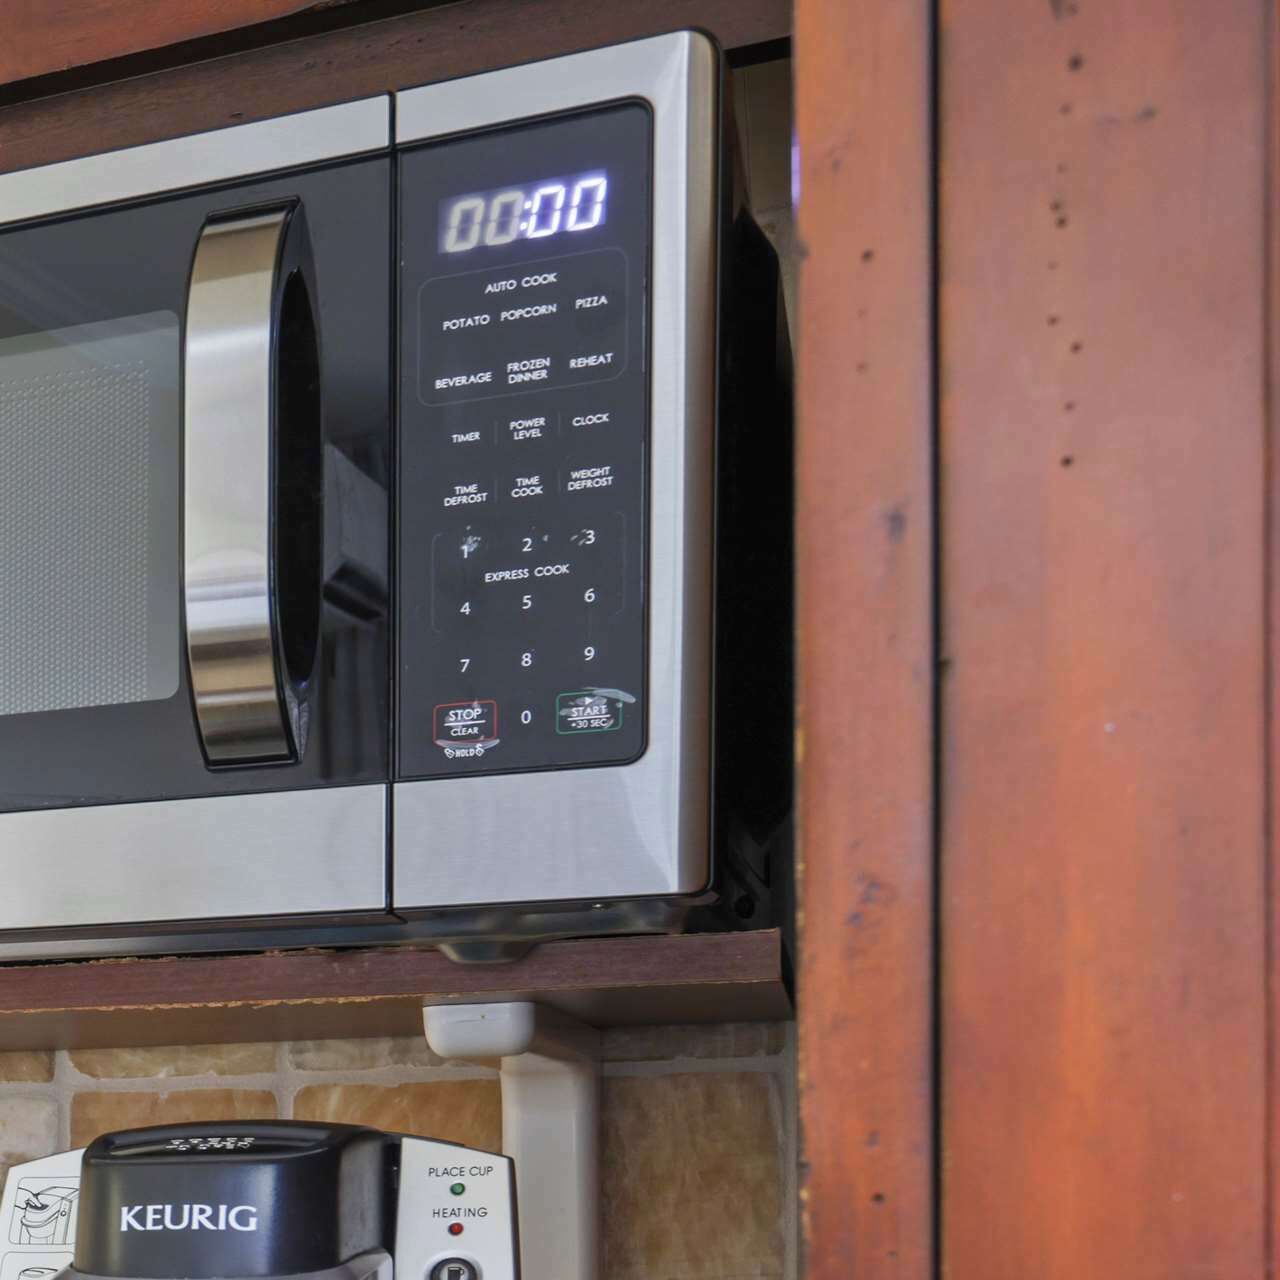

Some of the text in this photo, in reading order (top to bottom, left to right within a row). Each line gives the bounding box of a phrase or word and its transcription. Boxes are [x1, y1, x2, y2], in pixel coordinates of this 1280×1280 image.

[445, 176, 608, 253] 00:00
[484, 273, 558, 294] AUTO COOK
[576, 296, 608, 309] PIZZA
[500, 304, 557, 321] POPCORN
[442, 314, 490, 330] POTATO
[507, 358, 550, 372] FROZEN
[570, 353, 613, 368] REHEAT
[435, 372, 492, 389] BEVERAGE
[508, 370, 548, 384] DINNER
[510, 418, 546, 430] POWER
[572, 413, 610, 426] CLOCK
[452, 432, 480, 444] TIMER
[514, 429, 542, 440] LEVEL
[571, 466, 611, 480] WEIGHT
[516, 476, 540, 487] TIME
[568, 477, 614, 491] DEFROST
[454, 484, 478, 495] TIME
[511, 486, 543, 498] COOK
[444, 493, 488, 506] DEFROST
[585, 530, 596, 544] 3
[522, 538, 532, 552] 2
[484, 564, 569, 582] EXPRESS COOK
[584, 588, 595, 602] 6
[460, 602, 471, 615] 4
[522, 595, 532, 609] 5
[521, 653, 532, 667] 8
[584, 647, 595, 660] 9
[460, 659, 470, 672] 7
[449, 709, 481, 721] STOP
[521, 710, 532, 723] 0
[571, 705, 607, 716] START
[450, 726, 479, 736] CLEAR
[455, 747, 475, 758] HOLD
[428, 1166, 494, 1177] PLACE CUP
[120, 1204, 258, 1232] KEURIG
[432, 1207, 488, 1218] HEATING
